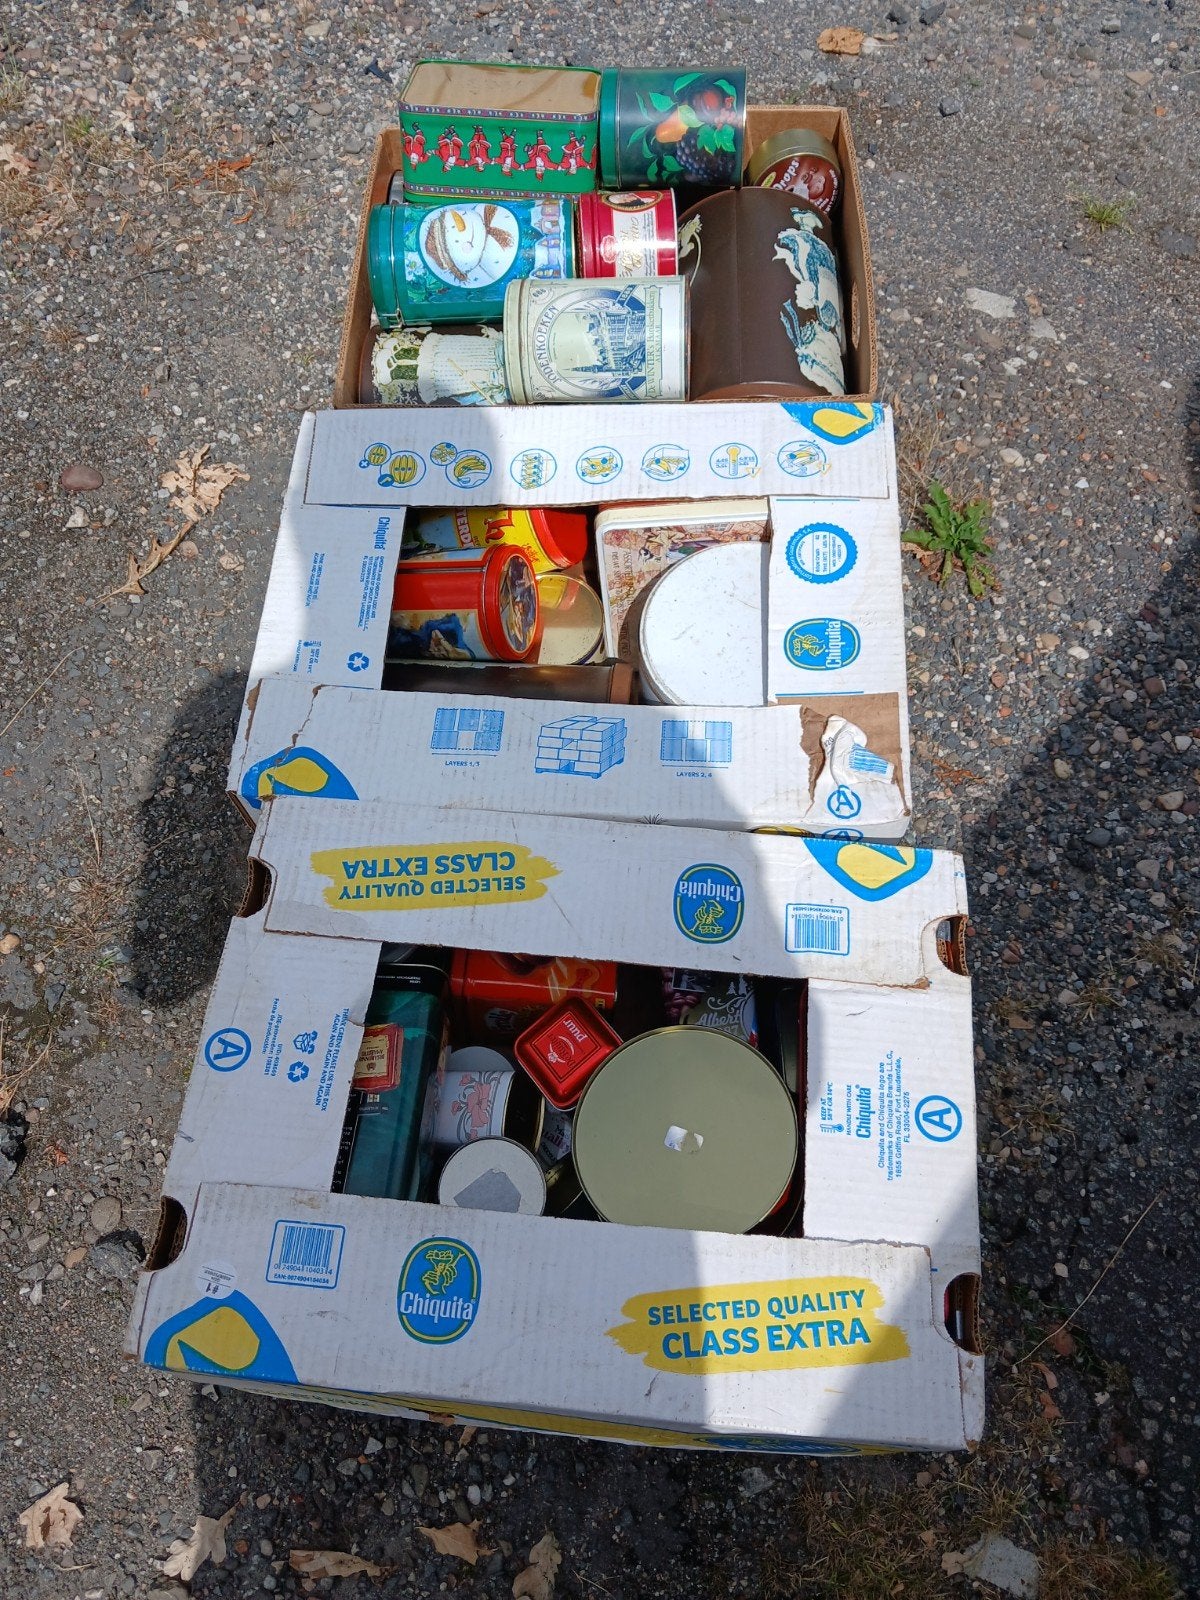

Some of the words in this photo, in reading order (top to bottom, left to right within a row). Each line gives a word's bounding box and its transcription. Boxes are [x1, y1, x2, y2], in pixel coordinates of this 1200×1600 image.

[773, 160, 800, 190] Drops
[535, 305, 562, 384] JODENKOEKEN
[373, 516, 391, 550] Chiquita
[825, 620, 846, 668] Chiquita
[342, 856, 428, 879] EXTRA
[435, 851, 516, 875] CLASS
[338, 879, 424, 900] QUALITY
[431, 876, 526, 894] SELECTED
[679, 879, 741, 902] Chiquita
[332, 1013, 341, 1033] AGAIN
[340, 1008, 349, 1026] THINK
[697, 1010, 741, 1027] Albert
[328, 1033, 336, 1048] AND
[563, 1019, 588, 1043] puur
[324, 1048, 332, 1069] AGAIN
[320, 1069, 328, 1084] AND
[315, 1084, 324, 1106] AGAIN
[324, 1082, 332, 1097] THIS
[321, 1097, 329, 1112] BOX
[855, 1086, 876, 1139] Chiquita
[205, 1282, 219, 1295] #1
[400, 1292, 475, 1323] Chiquita
[648, 1300, 760, 1325] SELECTED
[767, 1289, 865, 1319] QUALITY
[662, 1327, 759, 1360] CLASS
[766, 1317, 871, 1351] EXTRA
